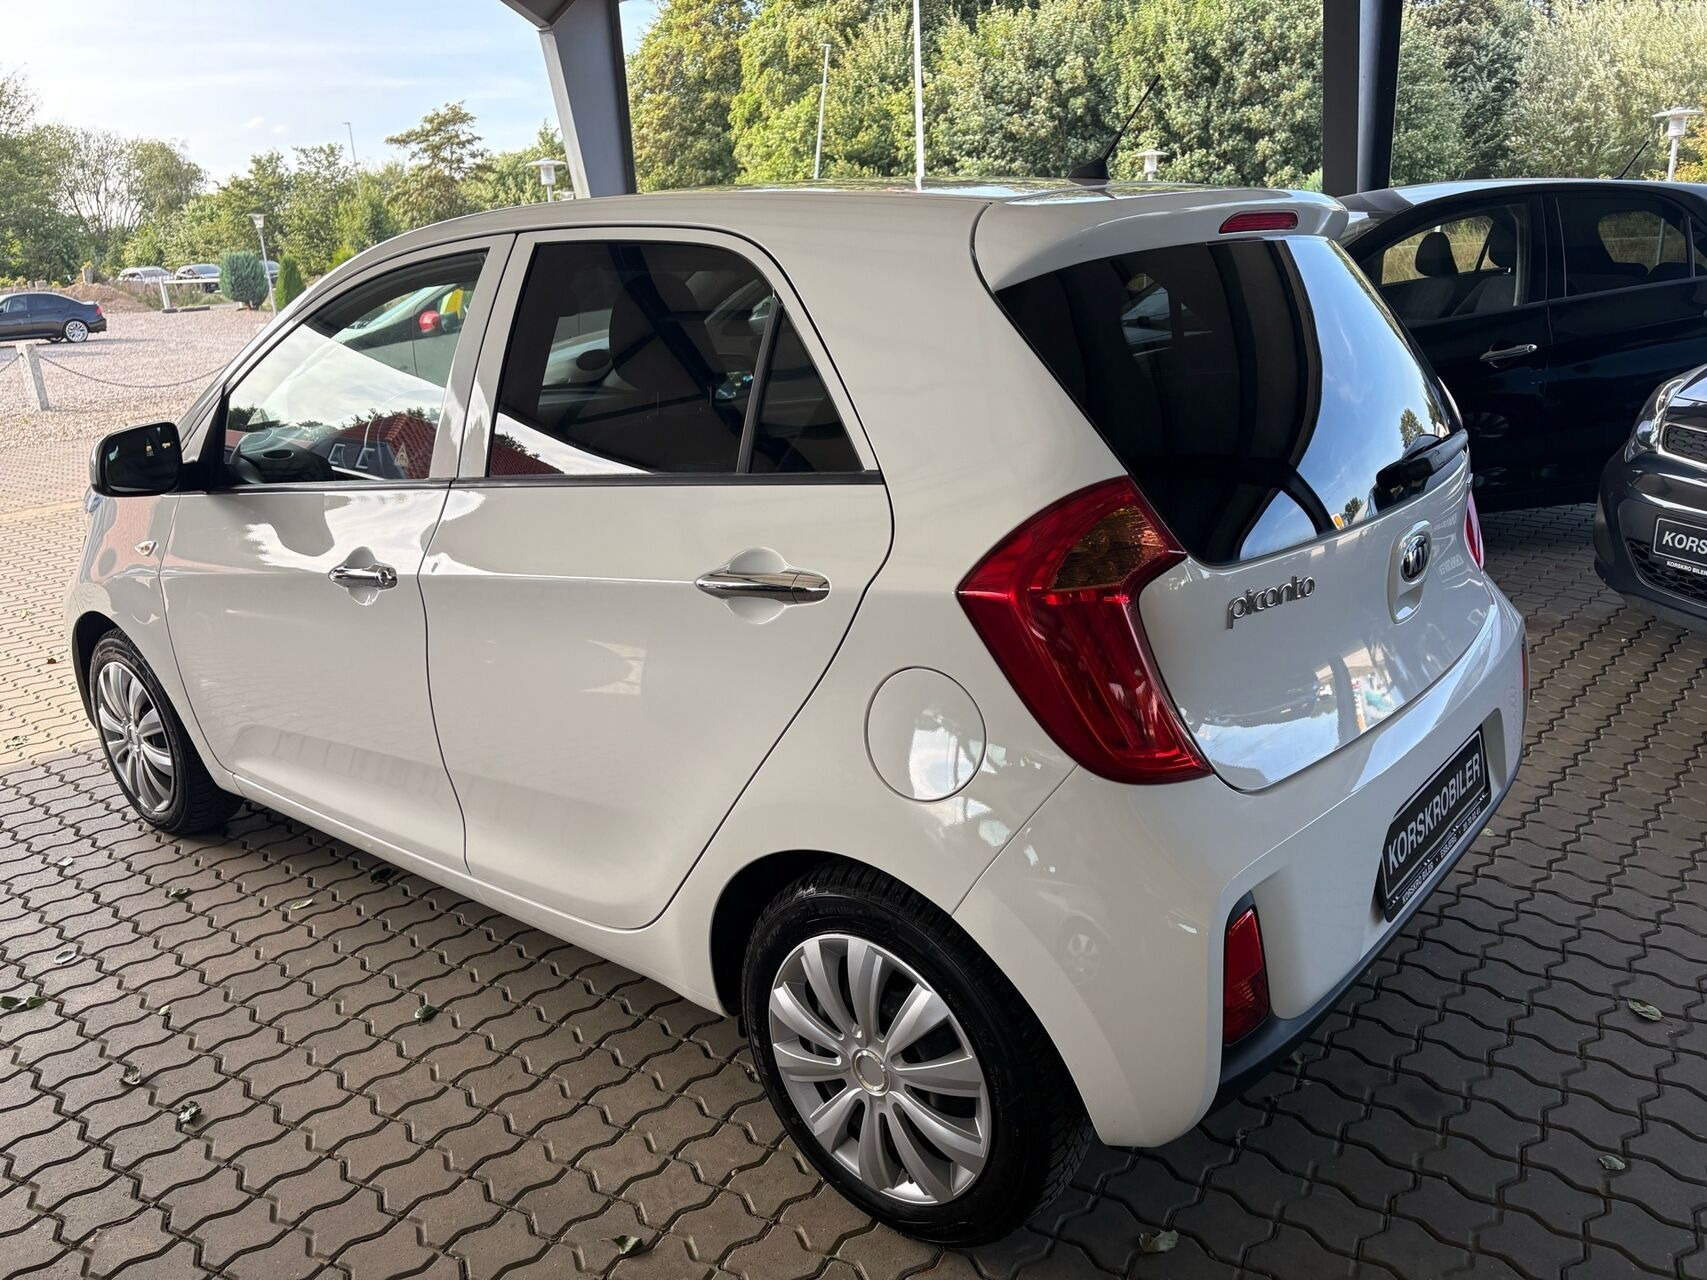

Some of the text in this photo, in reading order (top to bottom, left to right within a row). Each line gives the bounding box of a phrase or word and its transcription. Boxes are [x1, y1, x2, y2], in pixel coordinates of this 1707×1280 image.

[1666, 561, 1692, 572] KORSKRO
[1226, 575, 1316, 629] picanto
[1388, 752, 1480, 875] KORSKROBILER
